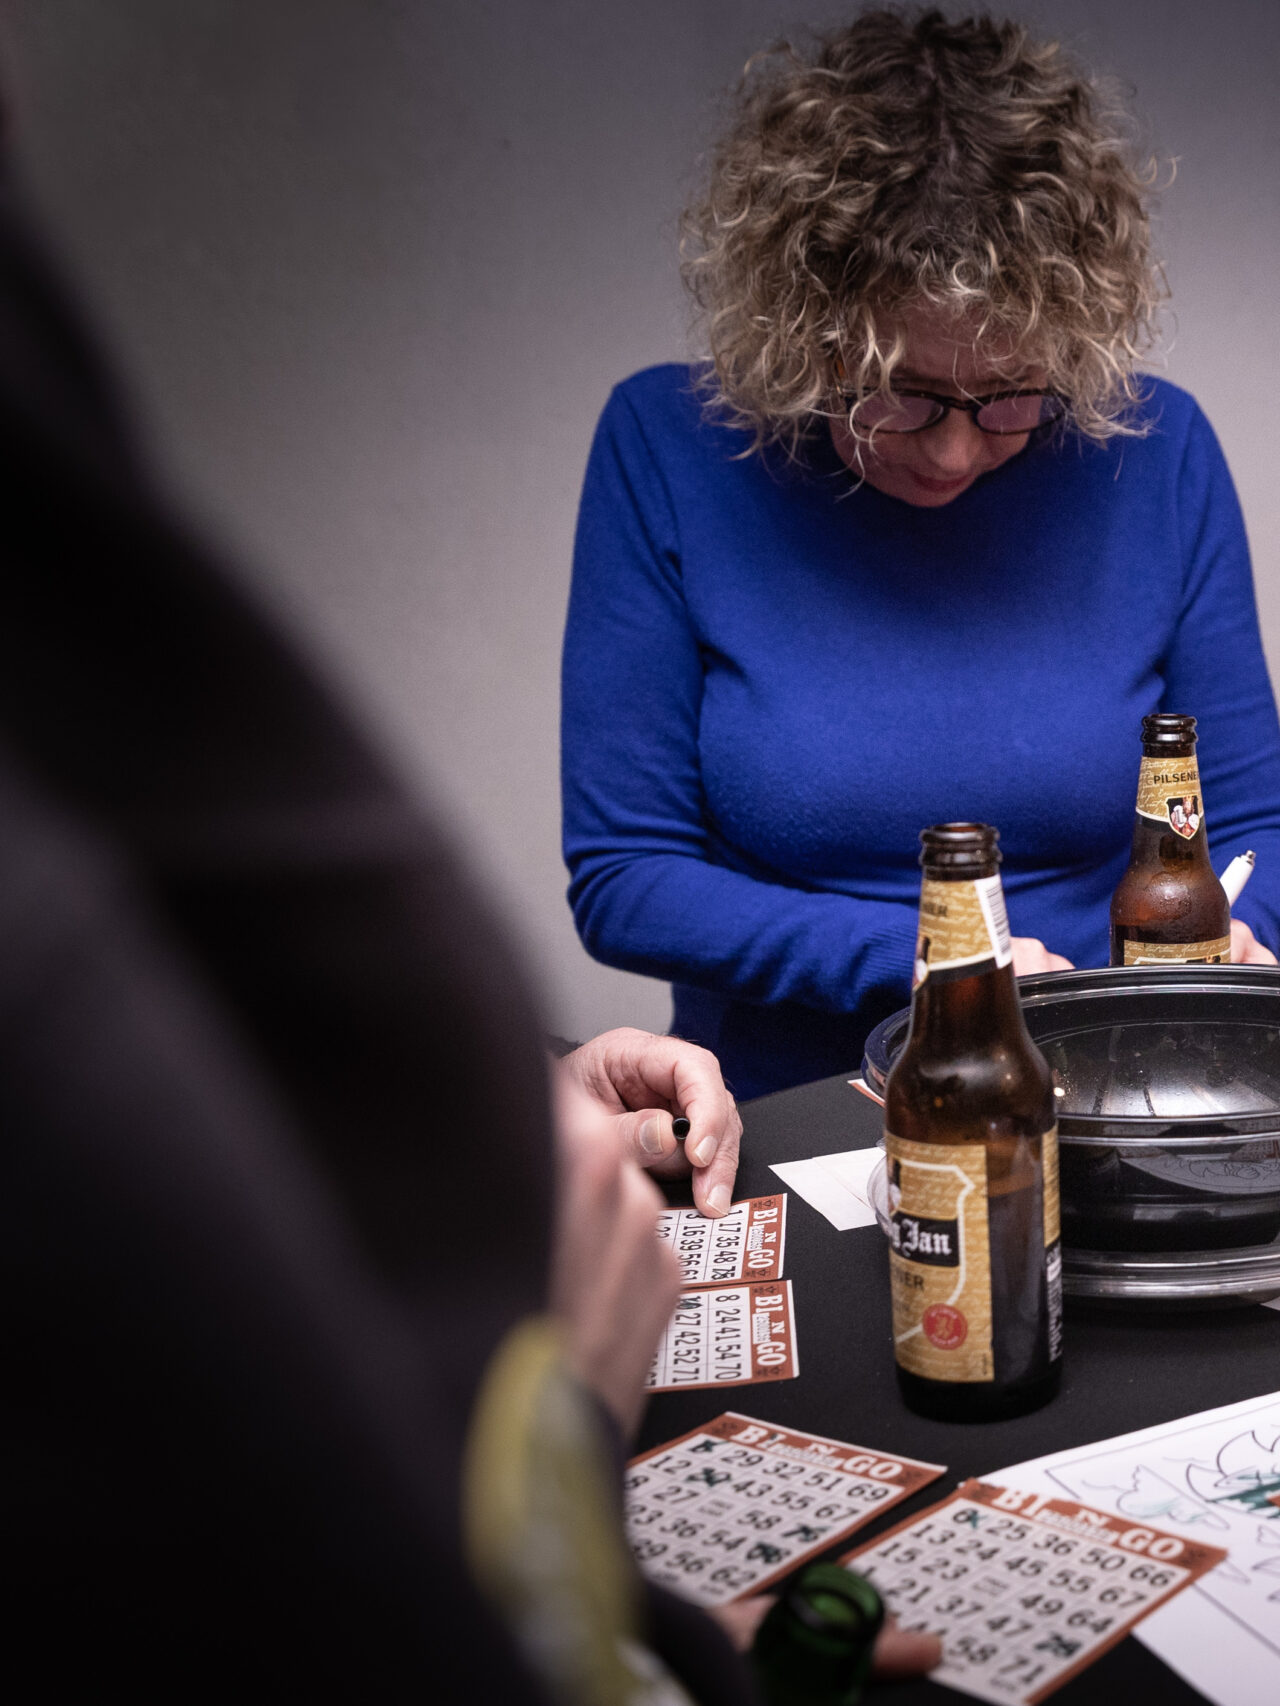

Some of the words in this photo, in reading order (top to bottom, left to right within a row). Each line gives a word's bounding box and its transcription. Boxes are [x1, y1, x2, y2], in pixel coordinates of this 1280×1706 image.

[1154, 771, 1197, 784] PILSENE
[682, 1225, 706, 1236] 16
[718, 1222, 741, 1232] 17
[680, 1239, 704, 1250] 39
[716, 1236, 740, 1248] 35
[902, 1218, 952, 1257] Jan
[713, 1251, 737, 1263] 48
[675, 1313, 701, 1325] 27
[715, 1309, 741, 1323] 24
[674, 1331, 700, 1346] 42
[715, 1327, 741, 1341] 41
[673, 1349, 700, 1364] 52
[715, 1344, 741, 1360] 54
[672, 1368, 699, 1383] 71
[715, 1363, 742, 1380] 70
[721, 1450, 764, 1467] 29
[763, 1461, 805, 1480] 32
[804, 1471, 843, 1491] 51
[847, 1483, 889, 1501] 69
[648, 1455, 692, 1474] 12
[732, 1480, 773, 1498] 43
[771, 1491, 815, 1510] 55
[815, 1503, 859, 1522] 67
[652, 1485, 699, 1504] 27
[737, 1510, 782, 1530] 58
[659, 1518, 706, 1538] 36
[702, 1530, 747, 1551] 54
[986, 1519, 1032, 1540] 25
[1033, 1534, 1078, 1555] 36
[1080, 1549, 1126, 1571] 50
[1129, 1564, 1176, 1586] 66
[665, 1551, 713, 1573] 56
[710, 1566, 756, 1588] 62
[912, 1524, 955, 1544] 13
[955, 1539, 999, 1560] 24
[1005, 1557, 1047, 1577] 45
[1049, 1569, 1096, 1593] 55
[1099, 1586, 1147, 1608] 67
[878, 1543, 921, 1563] 15
[921, 1557, 968, 1580] 23
[1019, 1595, 1064, 1616] 49
[1066, 1607, 1115, 1635] 64
[935, 1595, 984, 1618] 37
[987, 1616, 1033, 1638] 47
[1000, 1656, 1045, 1684] 71
